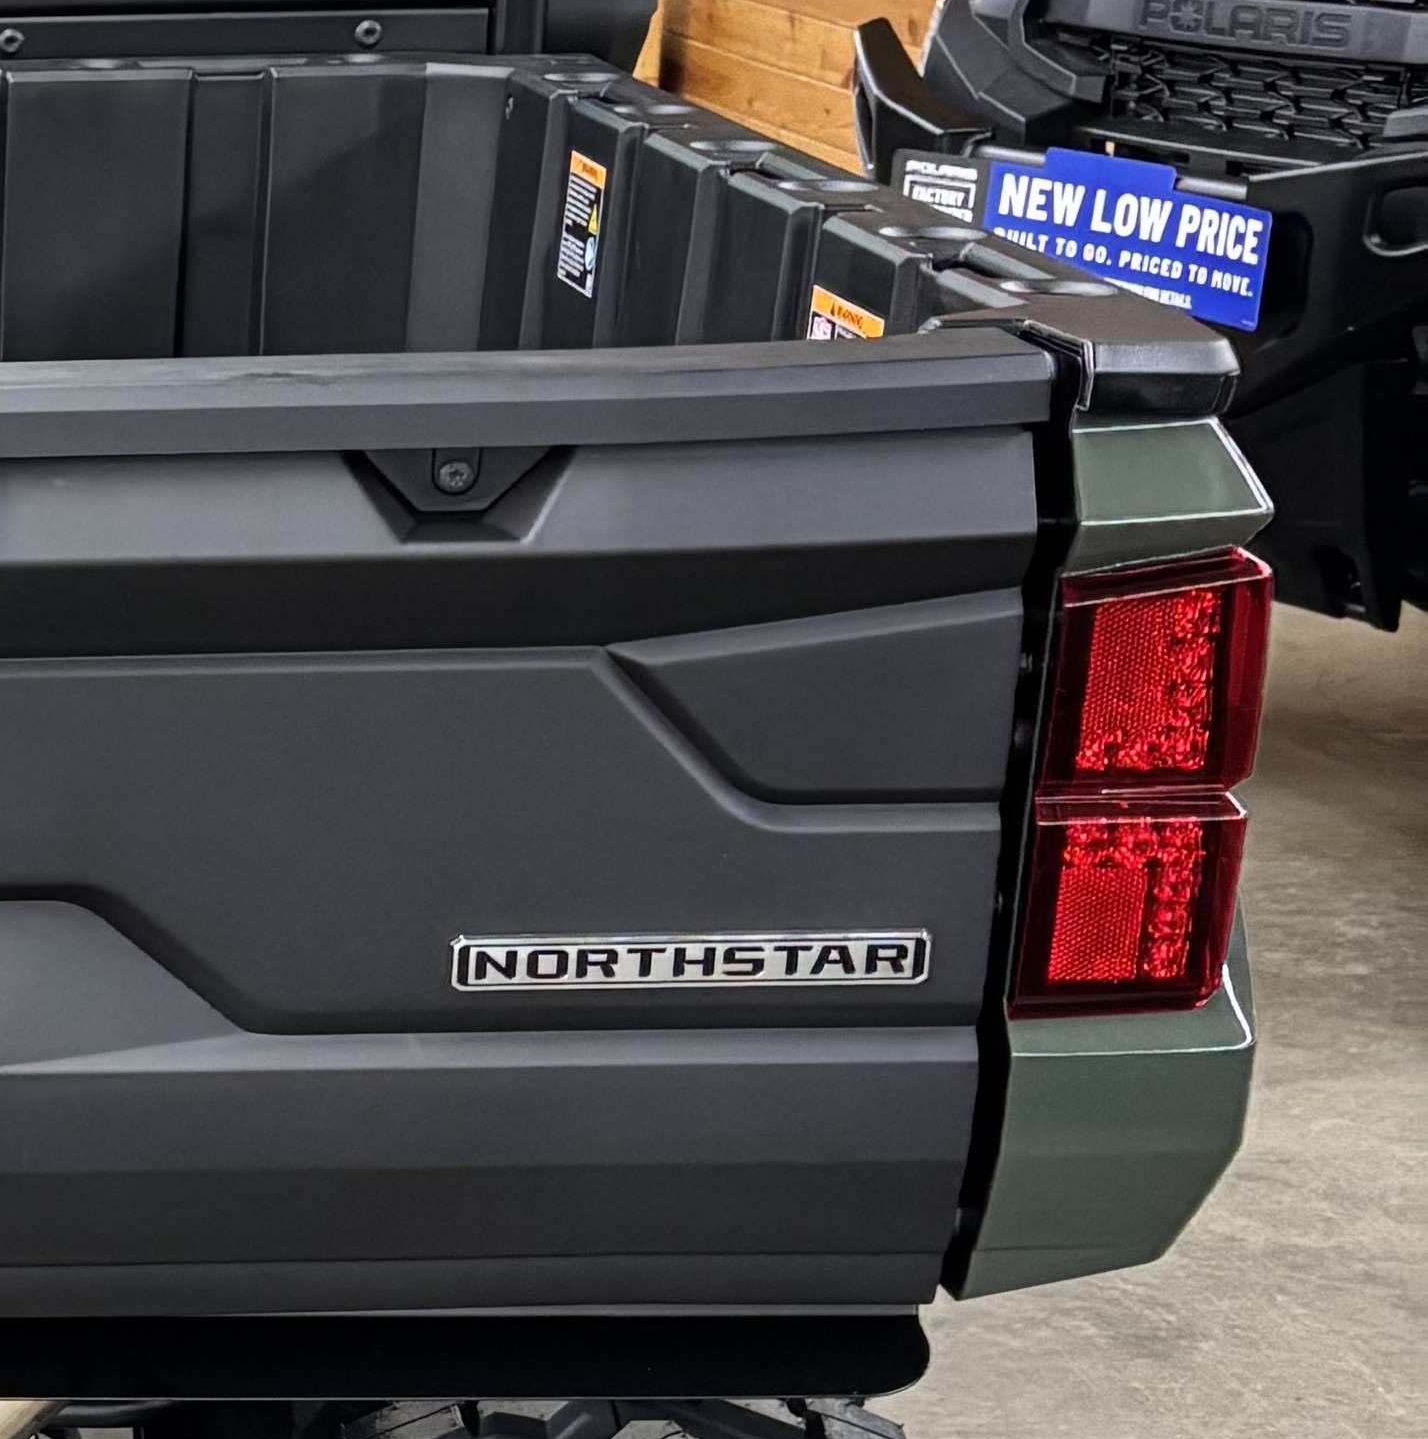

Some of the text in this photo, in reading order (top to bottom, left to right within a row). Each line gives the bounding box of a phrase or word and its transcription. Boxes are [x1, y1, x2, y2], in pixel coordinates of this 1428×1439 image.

[998, 172, 1264, 265] NEW LOW PRICE
[1055, 236, 1078, 258] TO
[1118, 249, 1184, 280] PRICED
[1188, 263, 1208, 285] TO
[1210, 269, 1254, 298] MOVE.
[473, 944, 910, 979] NORTHSTAR
